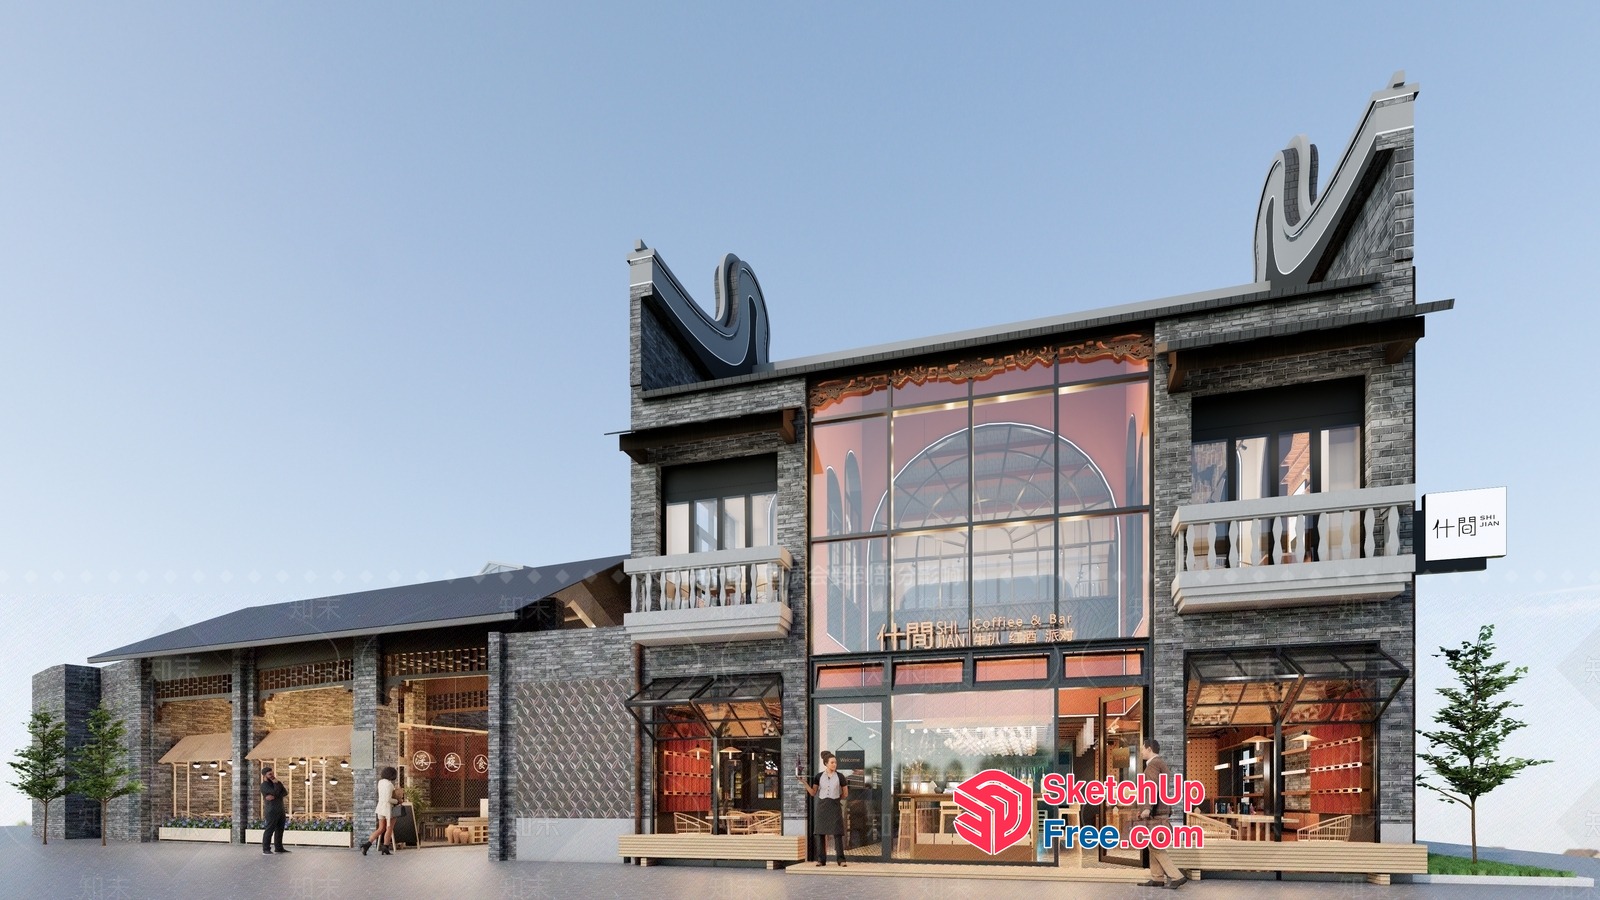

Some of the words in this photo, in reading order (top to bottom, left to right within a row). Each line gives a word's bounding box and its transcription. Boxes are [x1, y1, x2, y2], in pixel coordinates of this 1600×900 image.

[936, 620, 957, 635] SHI
[1030, 614, 1042, 627] &
[1049, 613, 1073, 625] Bar
[936, 634, 965, 649] JIAN
[973, 632, 1001, 646] 牛扒
[1009, 629, 1038, 644] 红酒
[1045, 628, 1075, 643] 派对
